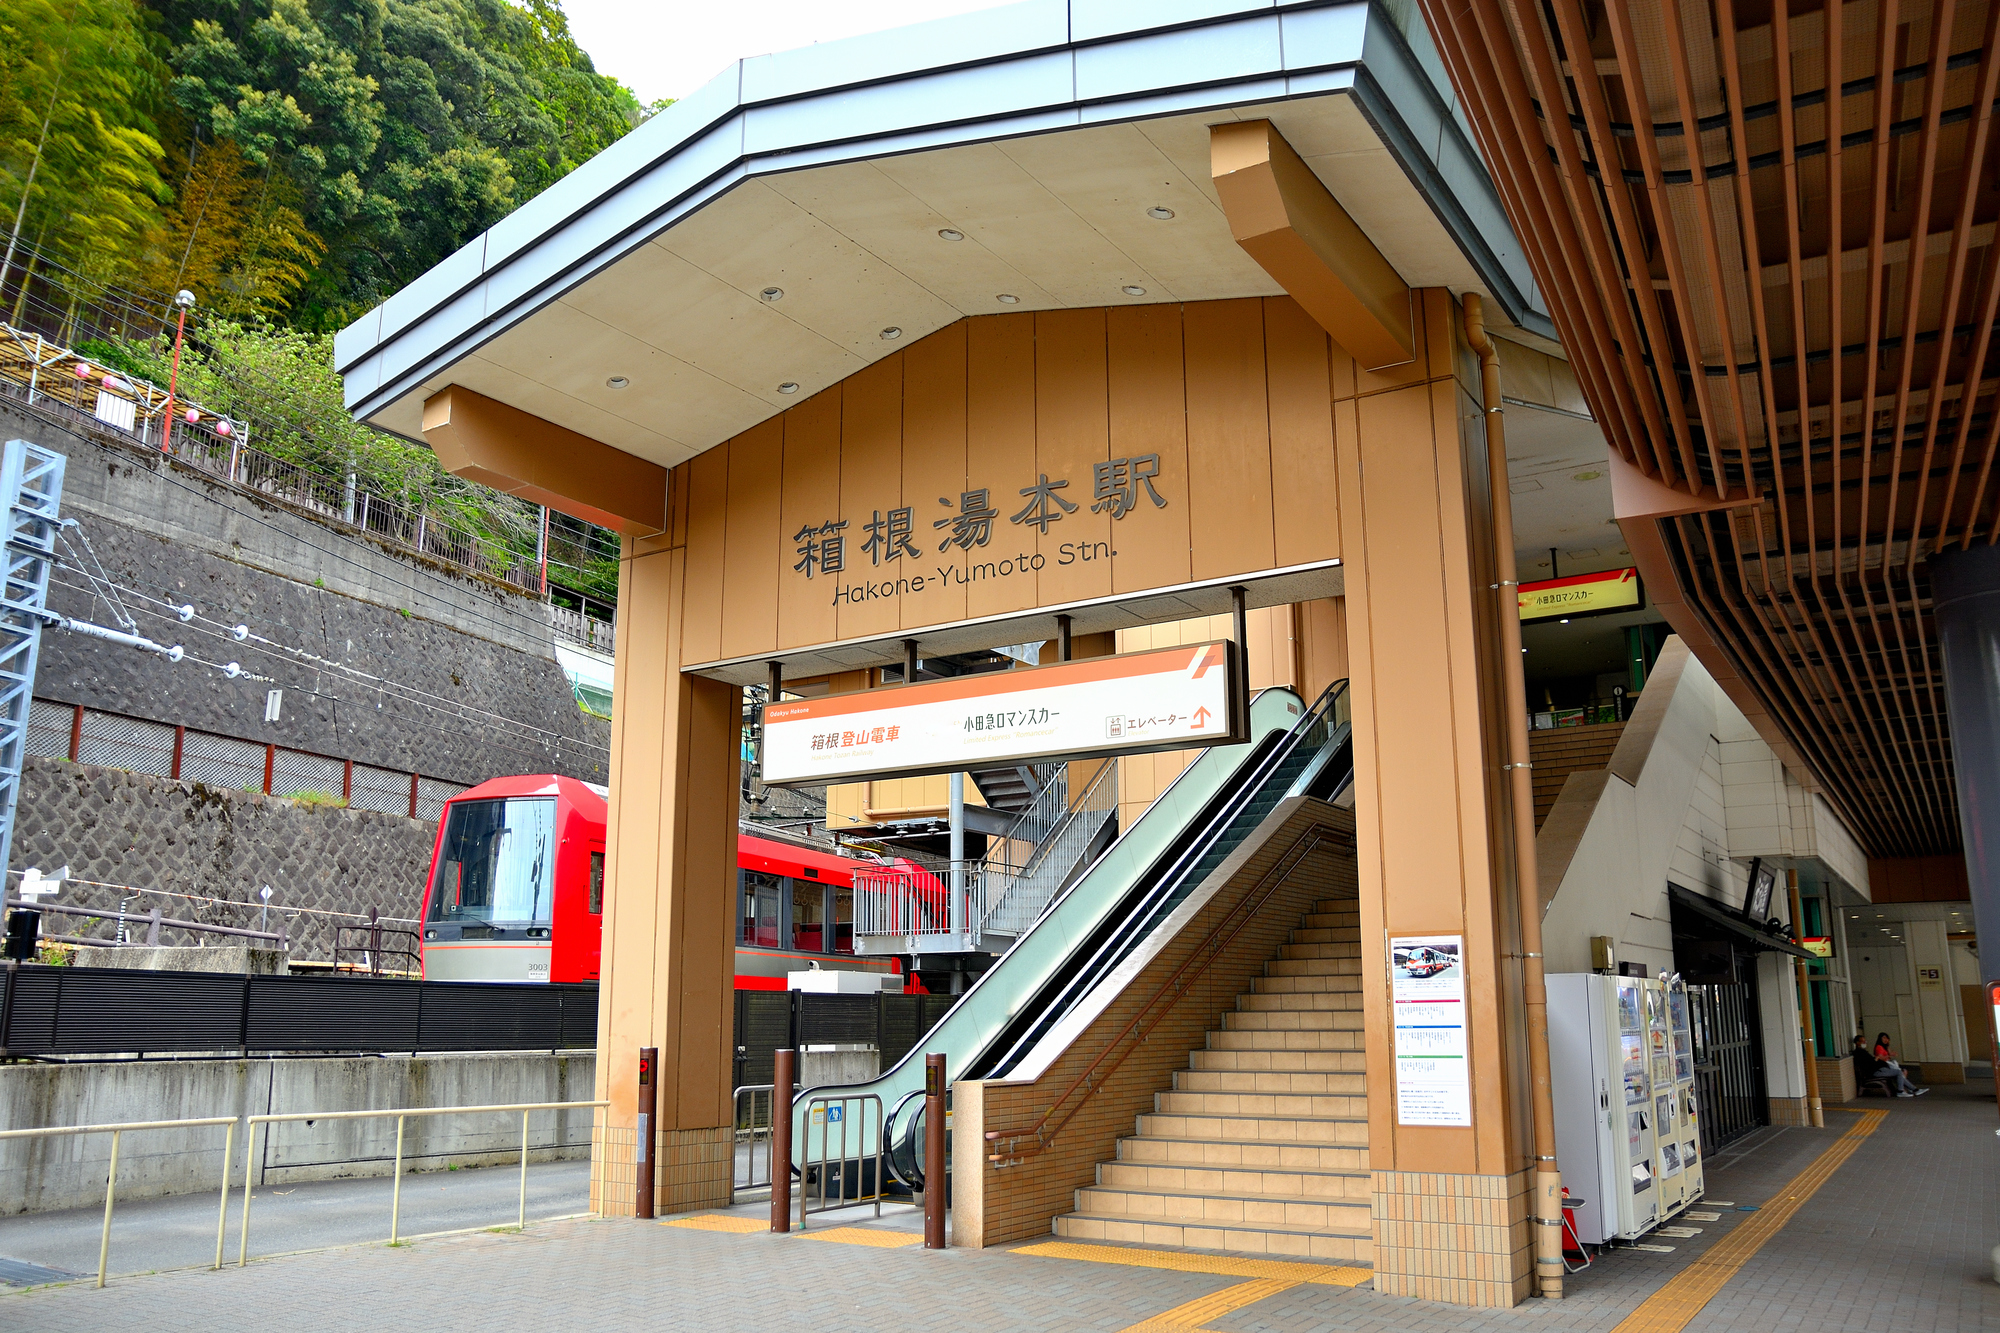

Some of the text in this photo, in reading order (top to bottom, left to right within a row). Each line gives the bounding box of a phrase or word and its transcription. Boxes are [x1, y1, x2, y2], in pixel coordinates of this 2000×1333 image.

[793, 453, 1167, 579] 箱根湯本駅
[832, 541, 1118, 606] Hakone-Yumoto Stn.
[770, 710, 789, 718] Odakyu
[964, 707, 1060, 732] 小田急ロマンスカー
[1127, 713, 1188, 729] エレベーター
[810, 725, 901, 751] 箱根登山電車
[963, 735, 987, 745] Limited
[987, 732, 1011, 743] Express
[1128, 729, 1150, 737] Elevator
[810, 748, 875, 761] Hakone Tozan Railway
[528, 963, 548, 971] 3003
